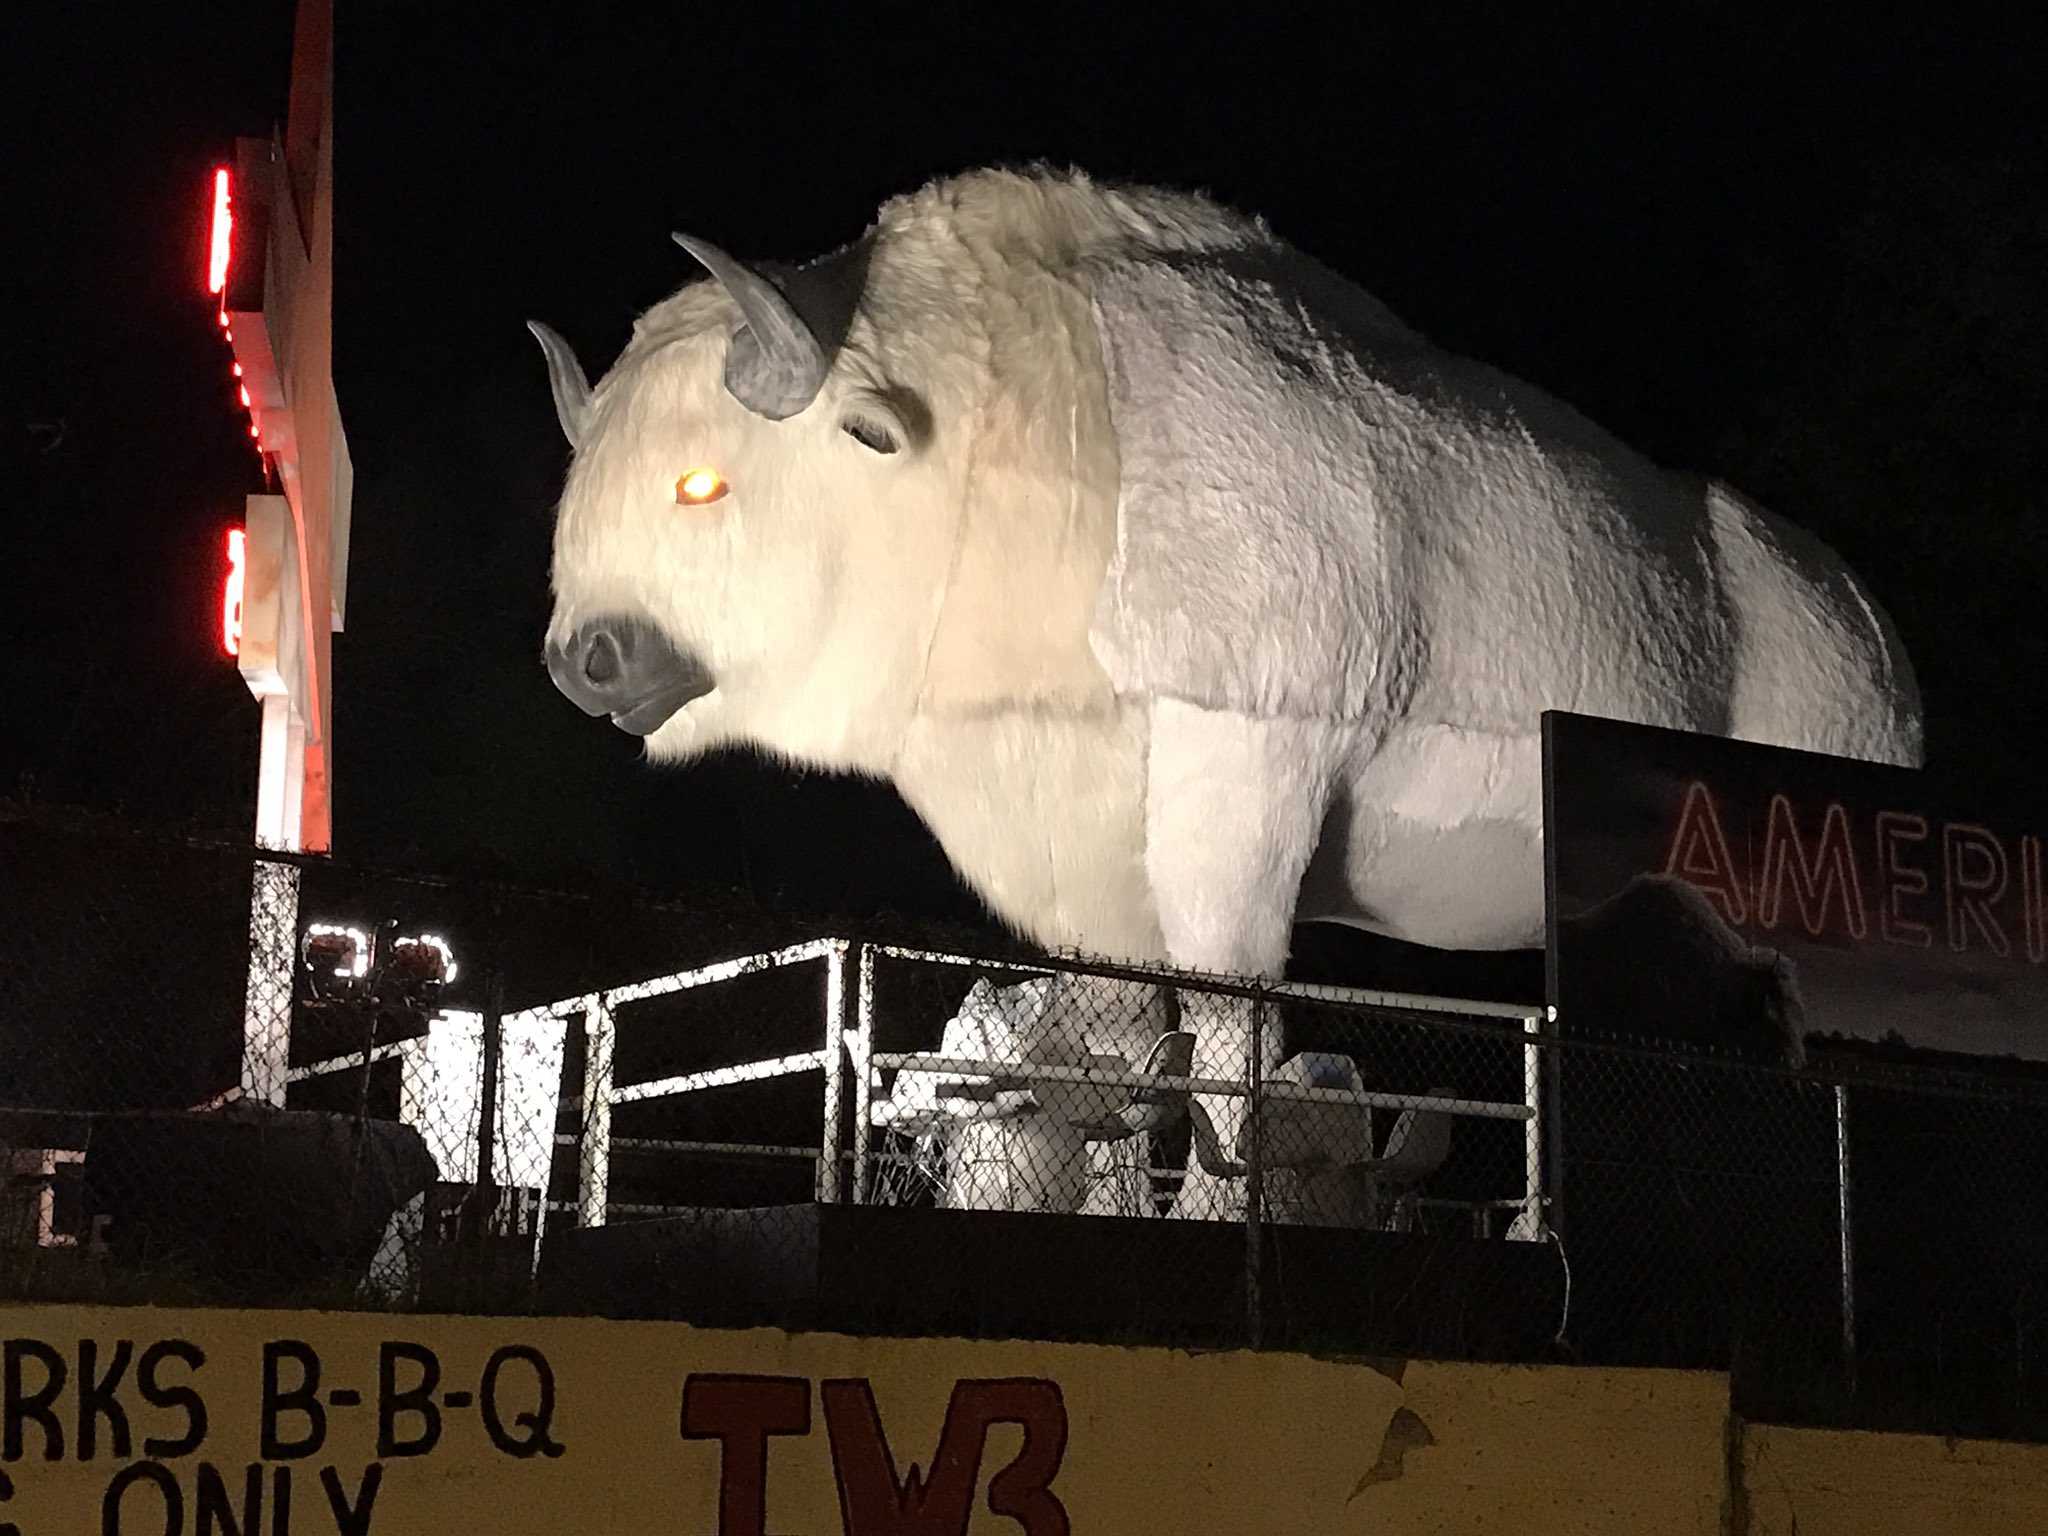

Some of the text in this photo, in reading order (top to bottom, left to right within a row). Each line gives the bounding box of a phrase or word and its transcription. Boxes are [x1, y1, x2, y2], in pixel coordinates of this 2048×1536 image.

[1665, 780, 2048, 963] AMERI
[2, 1339, 566, 1461] RKS B-B-Q
